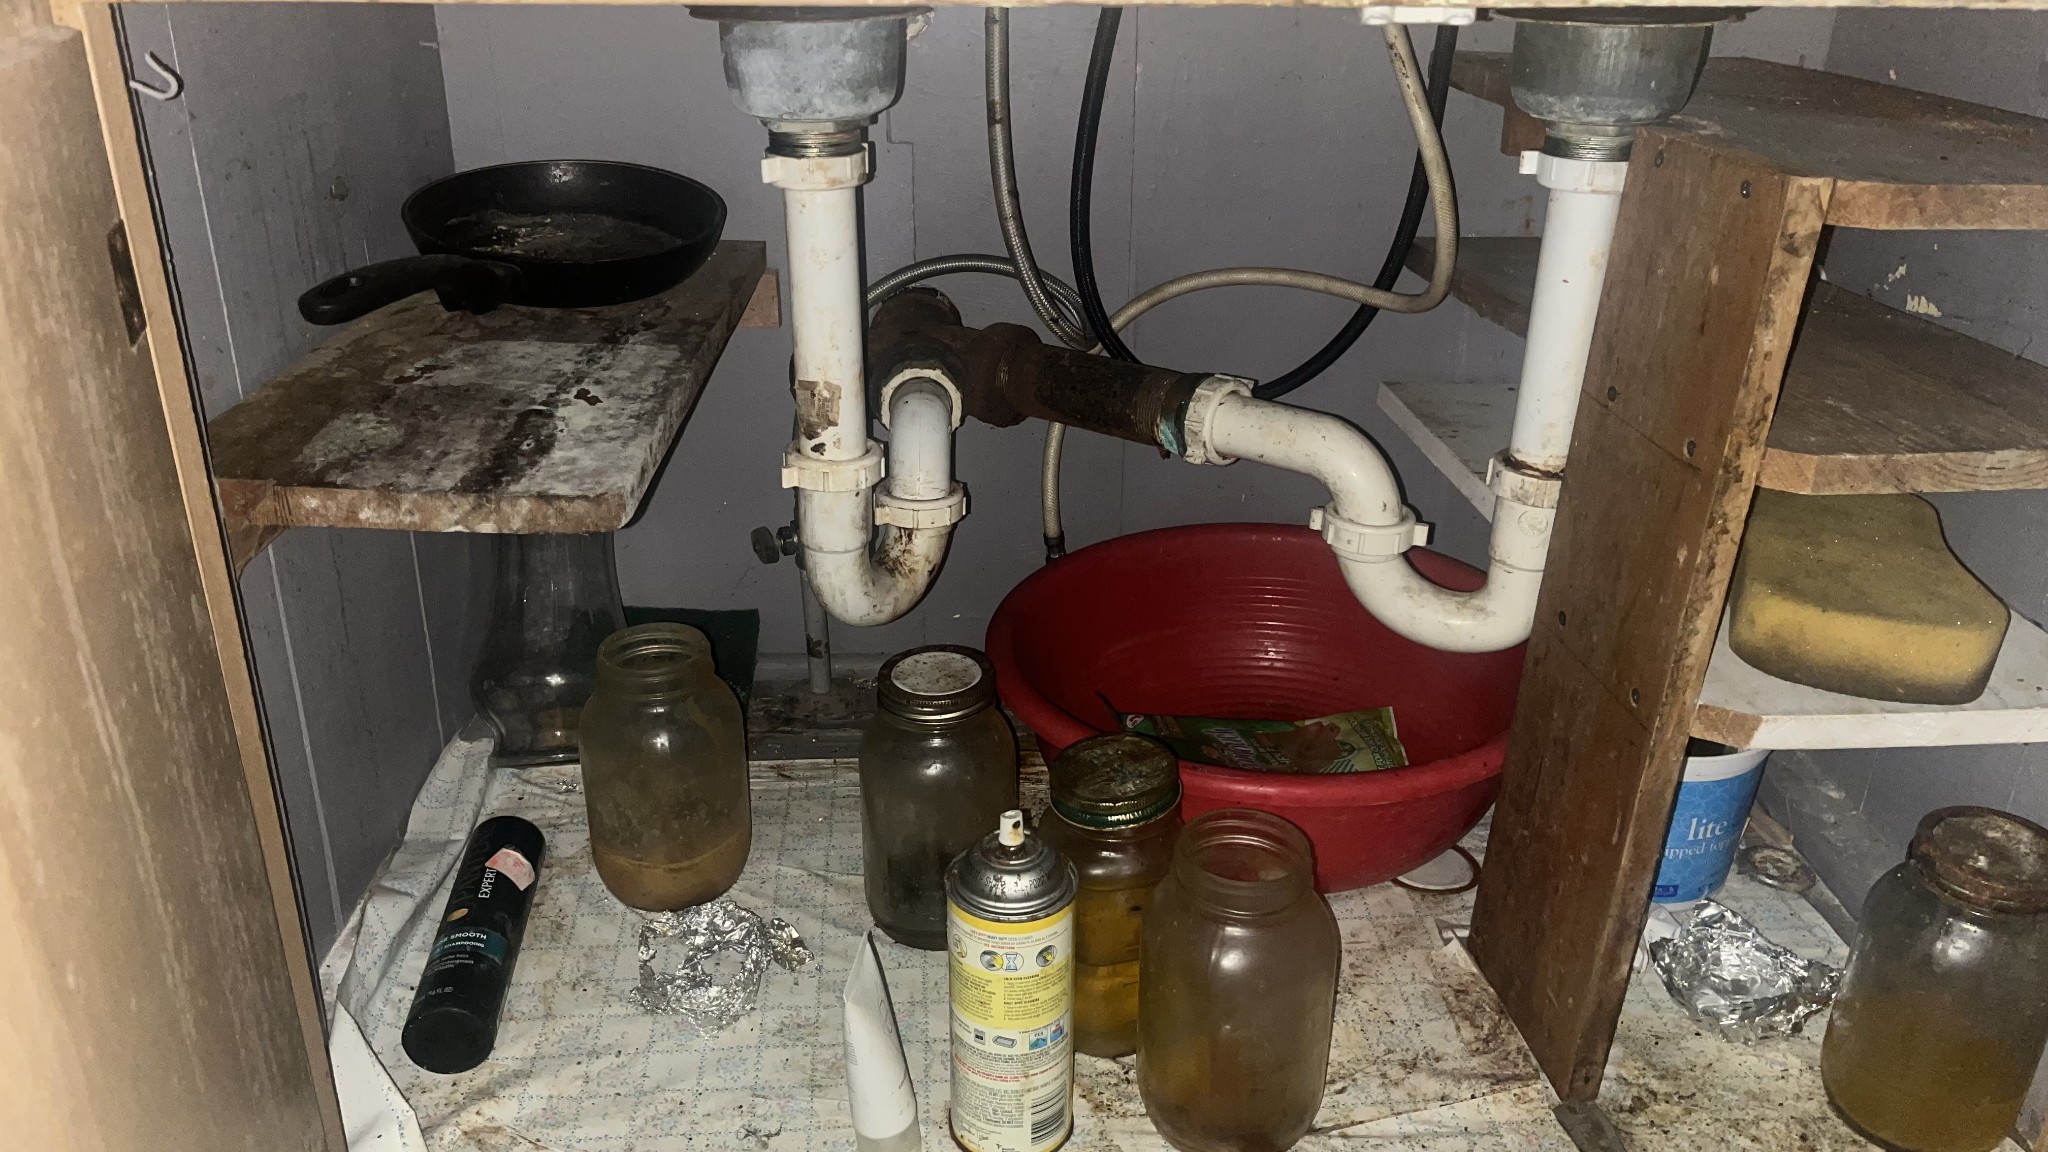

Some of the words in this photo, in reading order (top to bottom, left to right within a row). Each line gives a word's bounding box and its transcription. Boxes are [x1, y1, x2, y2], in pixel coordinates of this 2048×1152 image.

[1687, 817, 1728, 841] lite
[1664, 841, 1705, 860] ipped
[478, 868, 497, 899] EXPERT
[450, 931, 487, 940] SMOOTH
